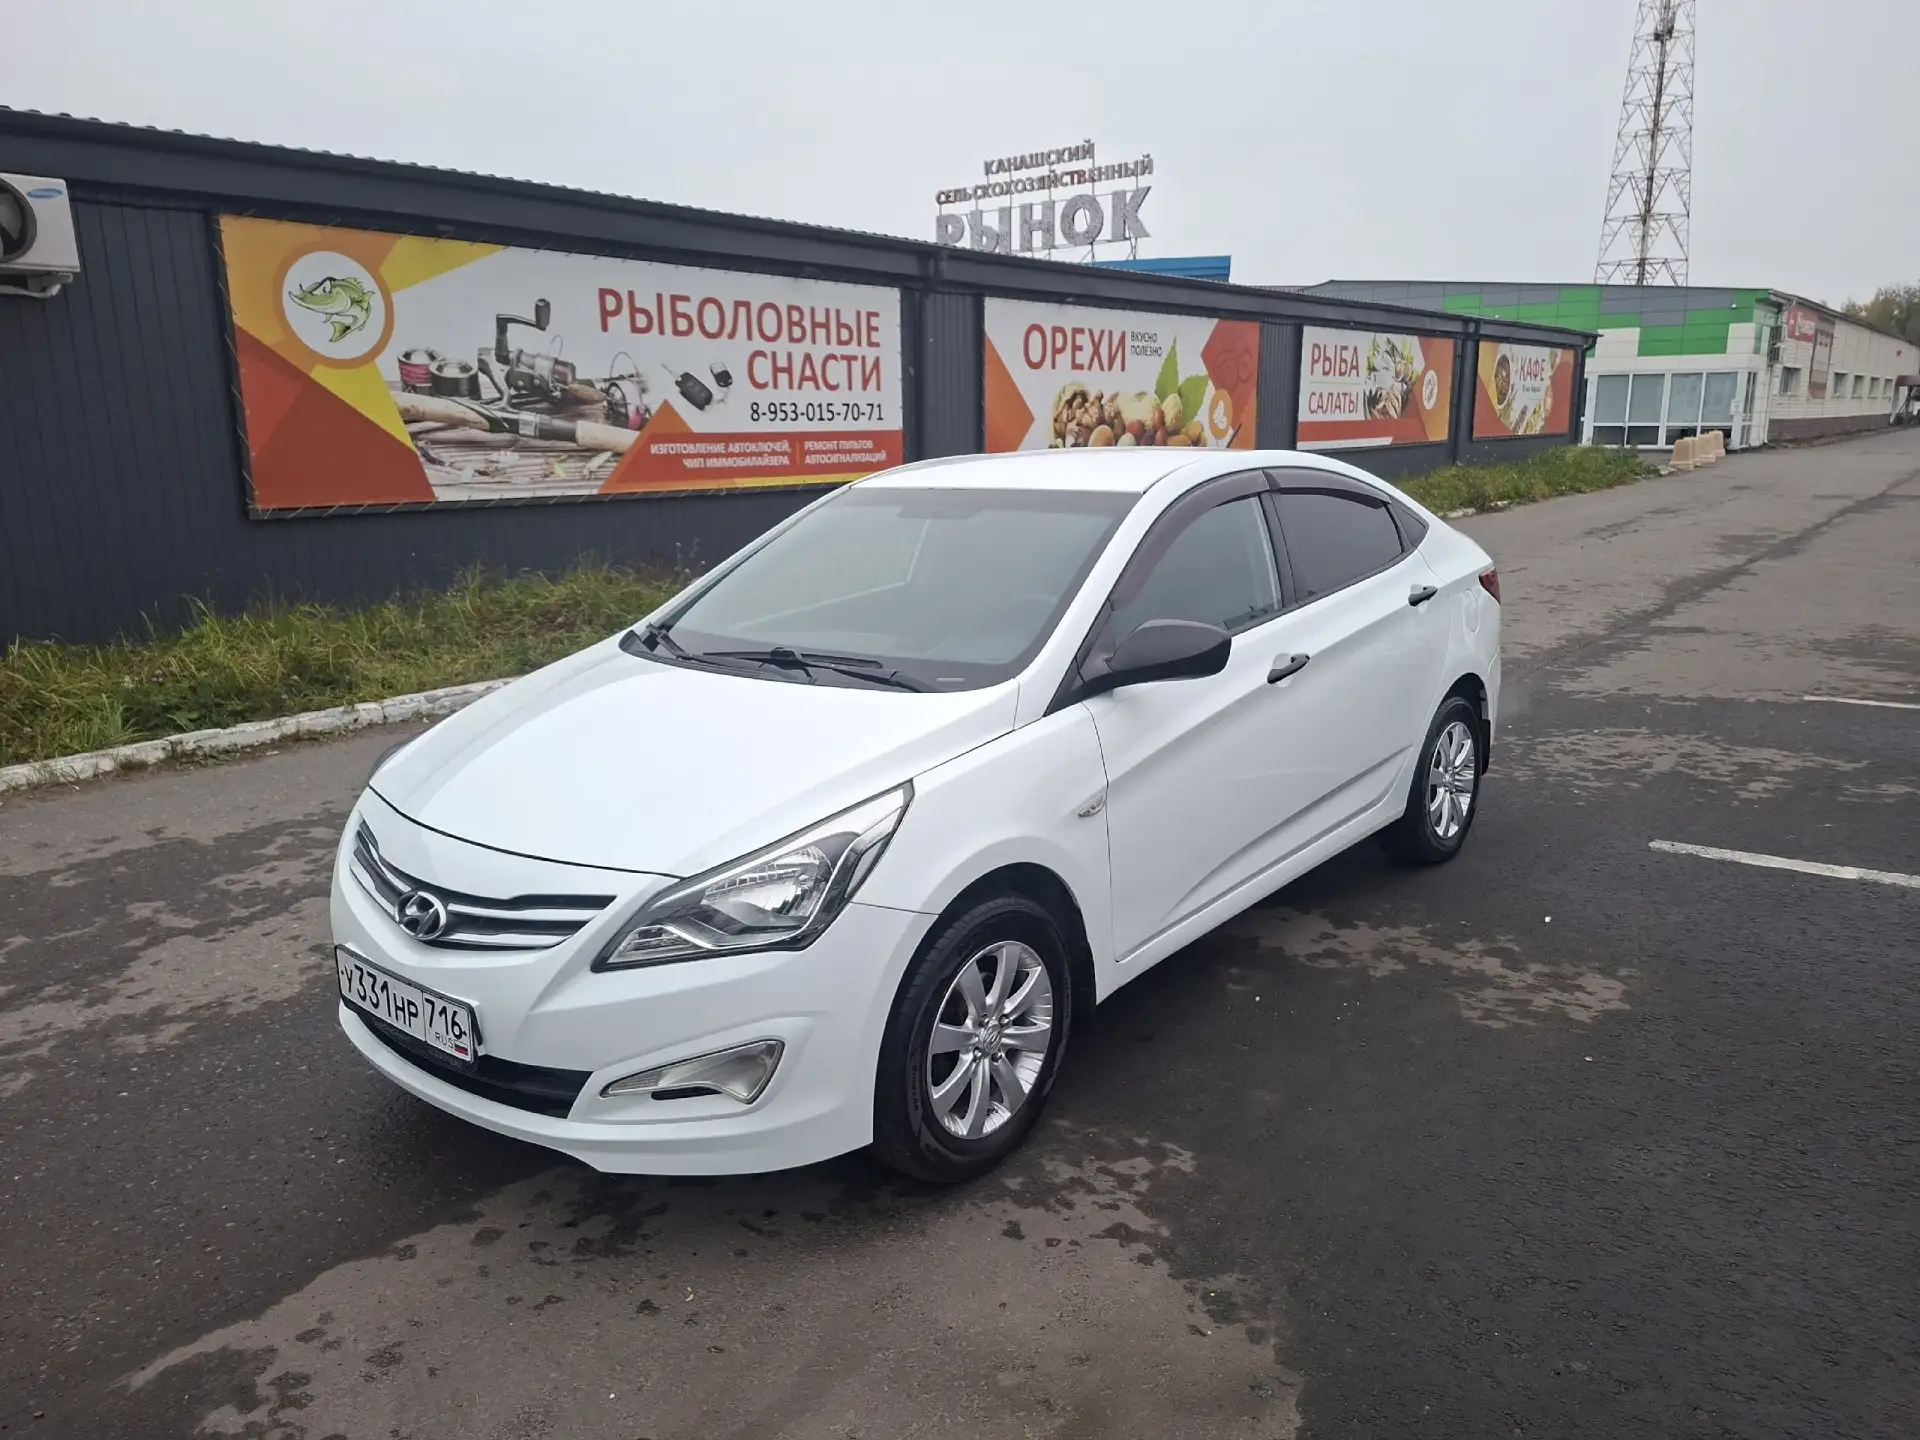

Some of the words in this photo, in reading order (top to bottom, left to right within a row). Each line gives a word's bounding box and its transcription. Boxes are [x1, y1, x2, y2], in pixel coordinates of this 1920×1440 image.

[984, 138, 1095, 176] КАНАШСКИЙ
[935, 153, 1154, 205] СЕЛЬСКОХОЗЯЙСТВЕННЫЙ
[936, 186, 1152, 254] РЫНОК
[598, 287, 881, 348] РЫБОЛОВНЫЕ
[1023, 323, 1126, 372] ОРЕХИ
[1130, 331, 1158, 343] ВКУСНО
[1130, 344, 1163, 357] ПОЛЕЗНО
[1310, 343, 1360, 377] РЫБА
[747, 349, 882, 392] СНАСТИ
[1519, 356, 1546, 382] КАФЕ
[750, 402, 884, 422] 8-953-015-70-71
[1308, 390, 1359, 415] САЛАТЫ
[650, 442, 726, 455] ИЗГОТОВЛЕНИЕ
[804, 441, 838, 451] РЕМОНТ
[839, 439, 874, 450] ПУЛЬТОВ
[804, 450, 888, 465] АВТОСИГНАЛИЗАЦИЙ
[683, 456, 704, 468] ЧИП
[706, 453, 790, 468] ИММОБИЛАЙЗЕРА
[435, 1031, 454, 1048] RUS
